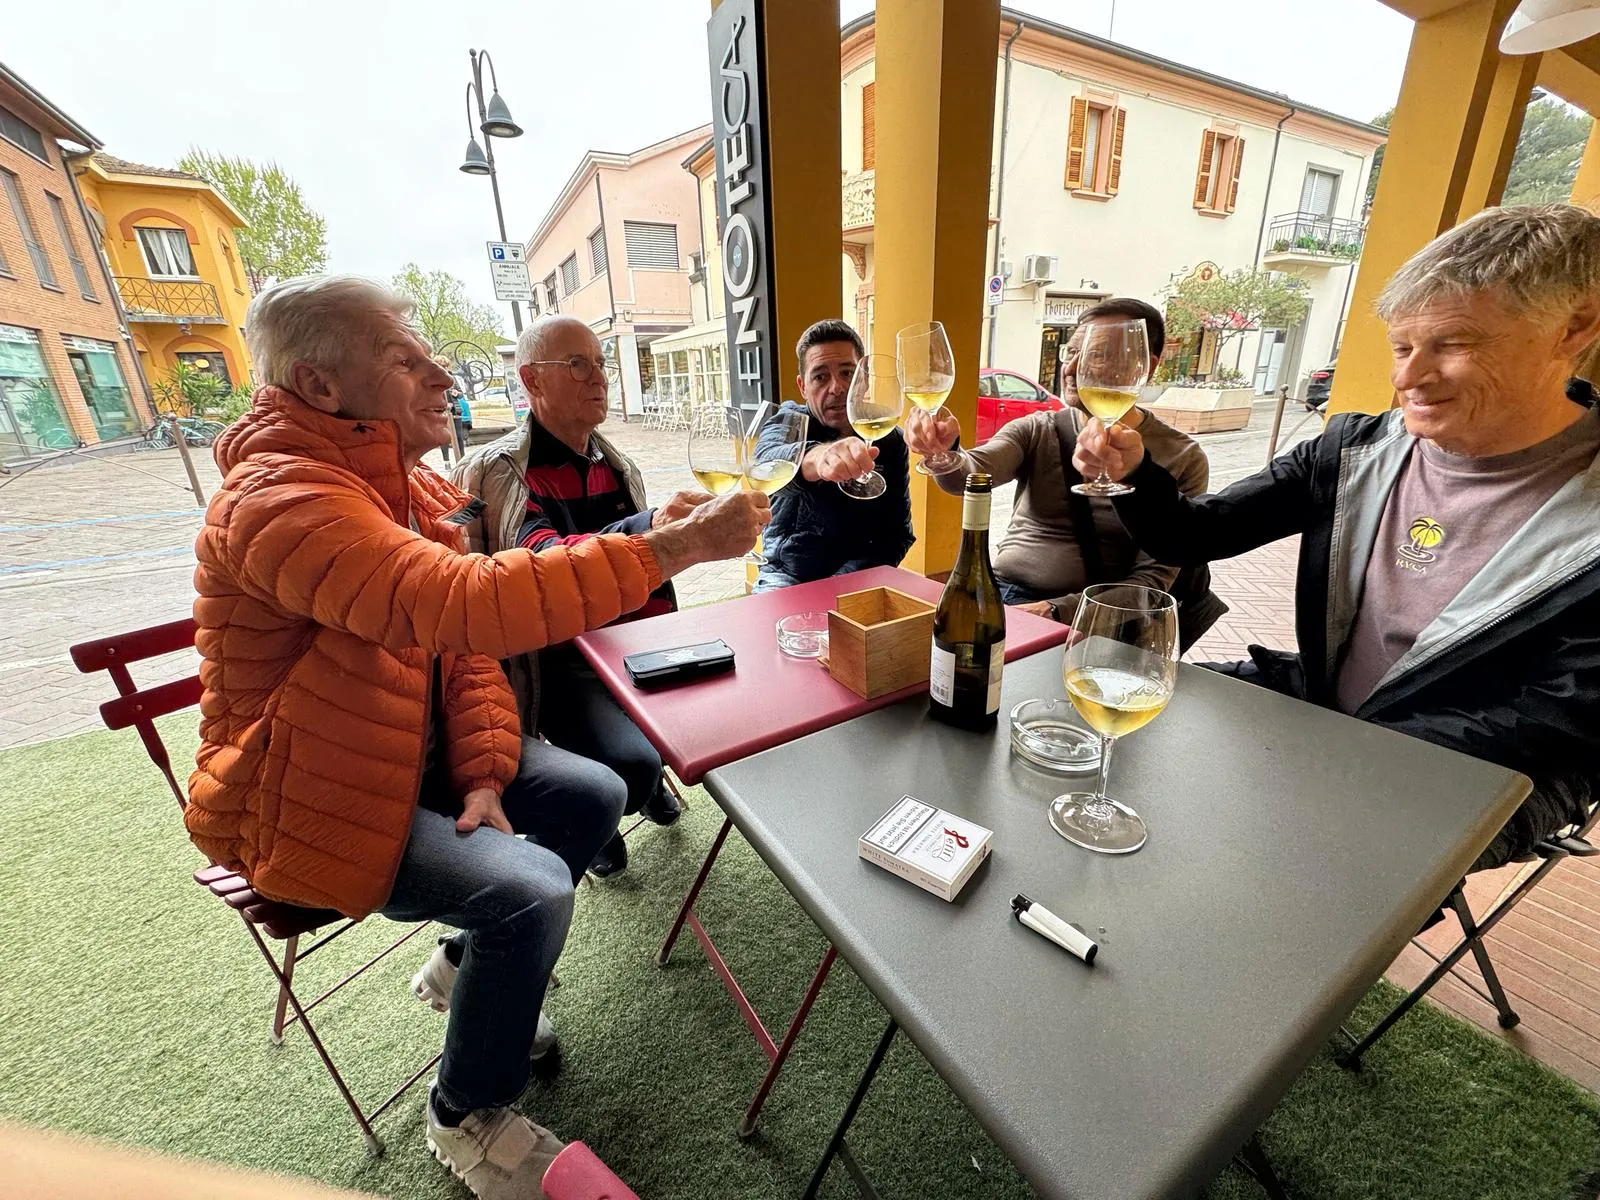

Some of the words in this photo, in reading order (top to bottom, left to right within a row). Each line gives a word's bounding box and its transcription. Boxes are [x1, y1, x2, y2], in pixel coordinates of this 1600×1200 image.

[494, 249, 502, 258] P
[1045, 300, 1090, 316] rboristeria
[907, 806, 930, 826] Rauchen
